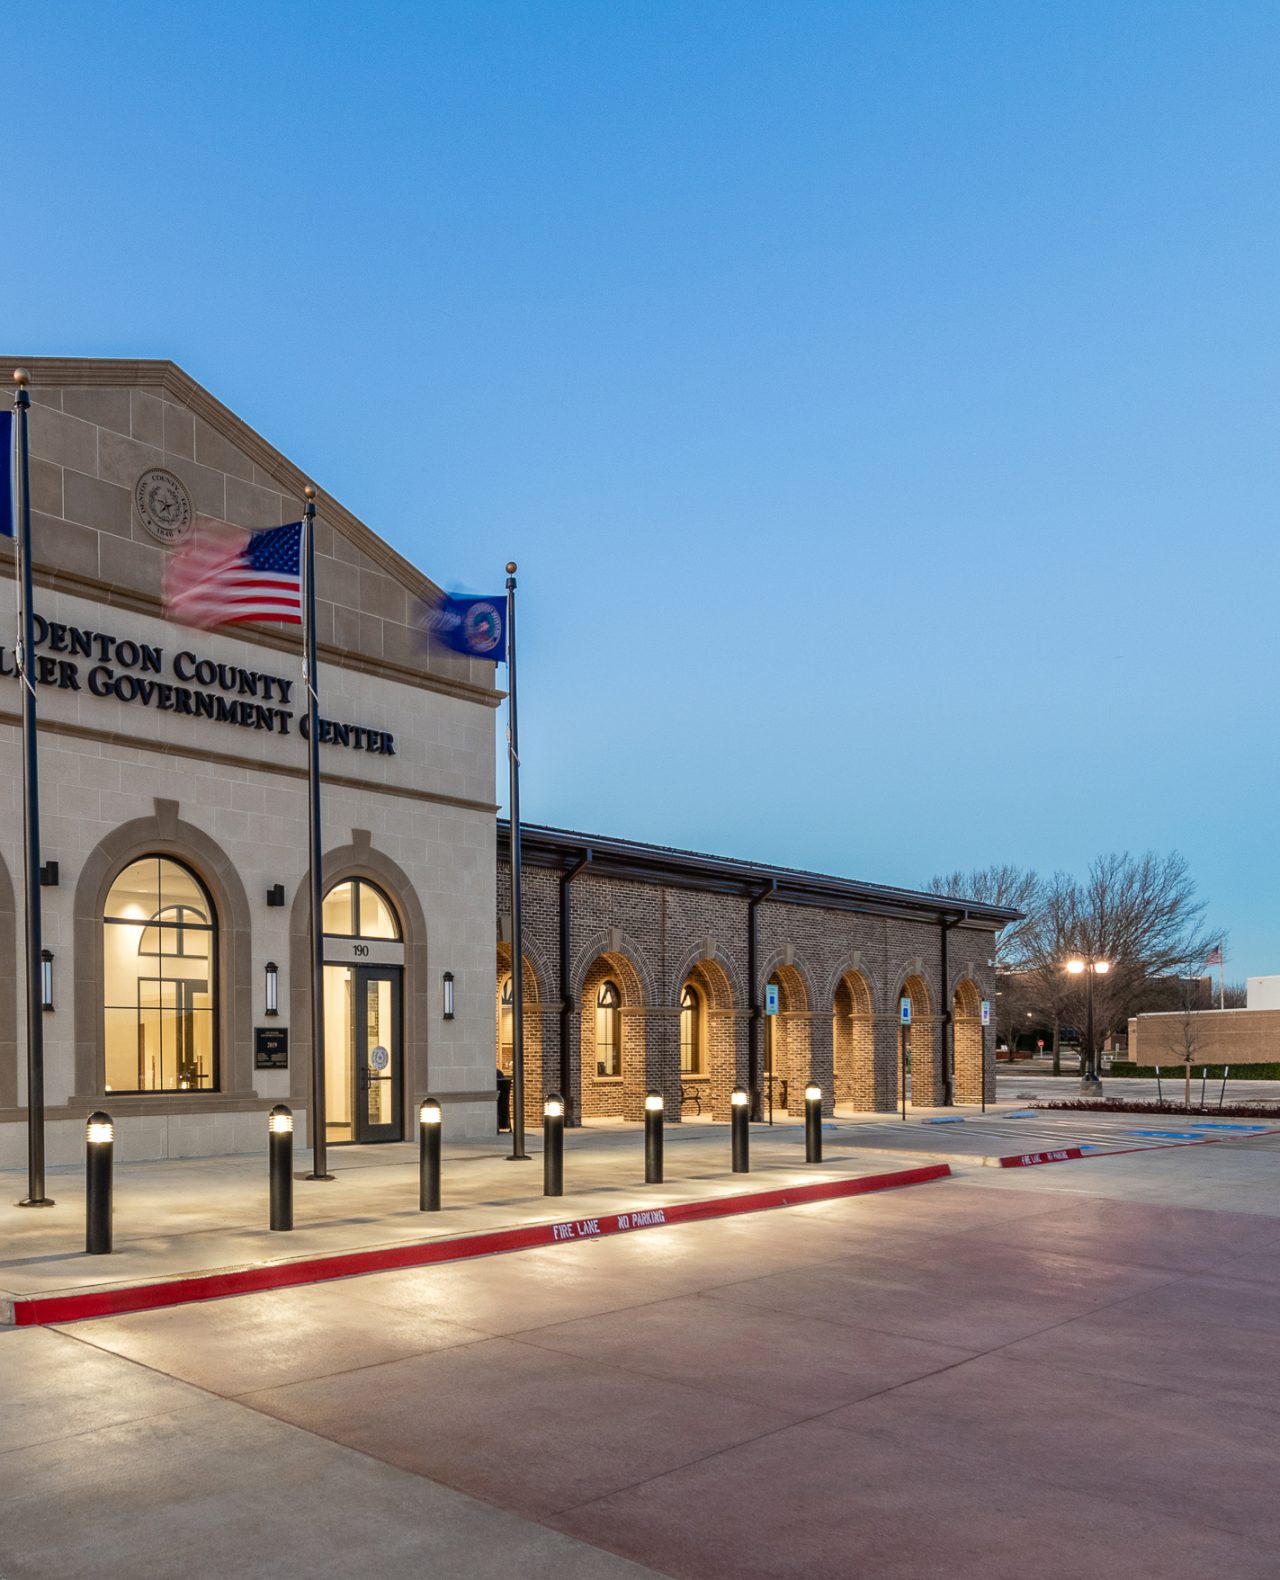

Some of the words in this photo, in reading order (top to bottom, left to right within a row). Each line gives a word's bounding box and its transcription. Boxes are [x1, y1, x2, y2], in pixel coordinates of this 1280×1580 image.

[173, 651, 294, 704] COUNTY
[87, 665, 294, 735] GOVERNMENT
[352, 944, 369, 957] 190
[552, 1223, 575, 1241] FIRE
[576, 1219, 601, 1236] LANE
[617, 1215, 630, 1230] NO
[631, 1209, 666, 1228] PARKING
